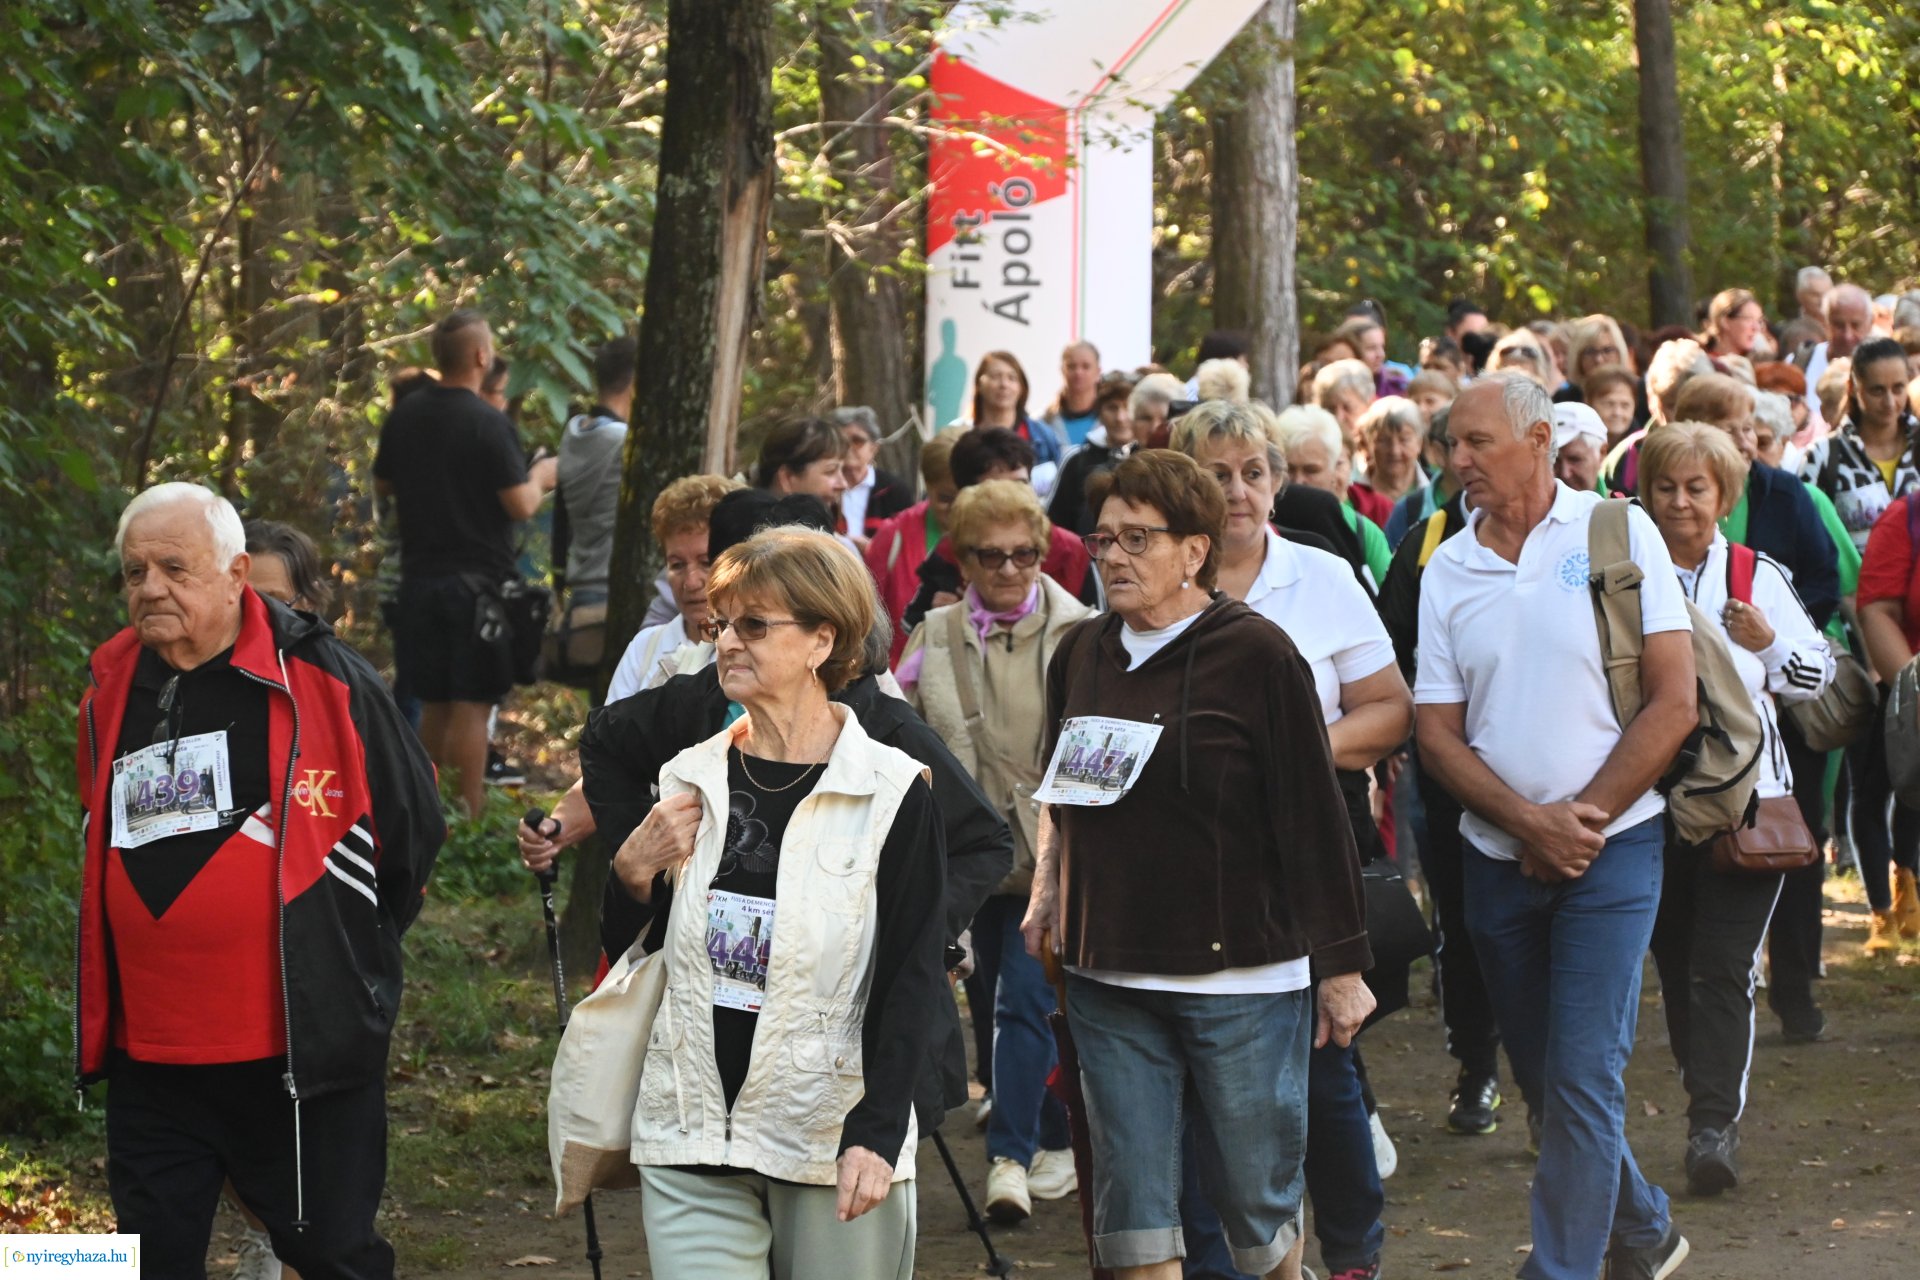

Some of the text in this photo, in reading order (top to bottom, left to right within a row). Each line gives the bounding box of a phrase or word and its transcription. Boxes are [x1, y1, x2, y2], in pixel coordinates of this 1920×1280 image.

[952, 209, 983, 289] Fitt
[982, 179, 1041, 326] Ápoló
[1065, 746, 1126, 778] 447
[135, 769, 201, 811] 439
[715, 895, 728, 903] TKM
[748, 906, 761, 914] km
